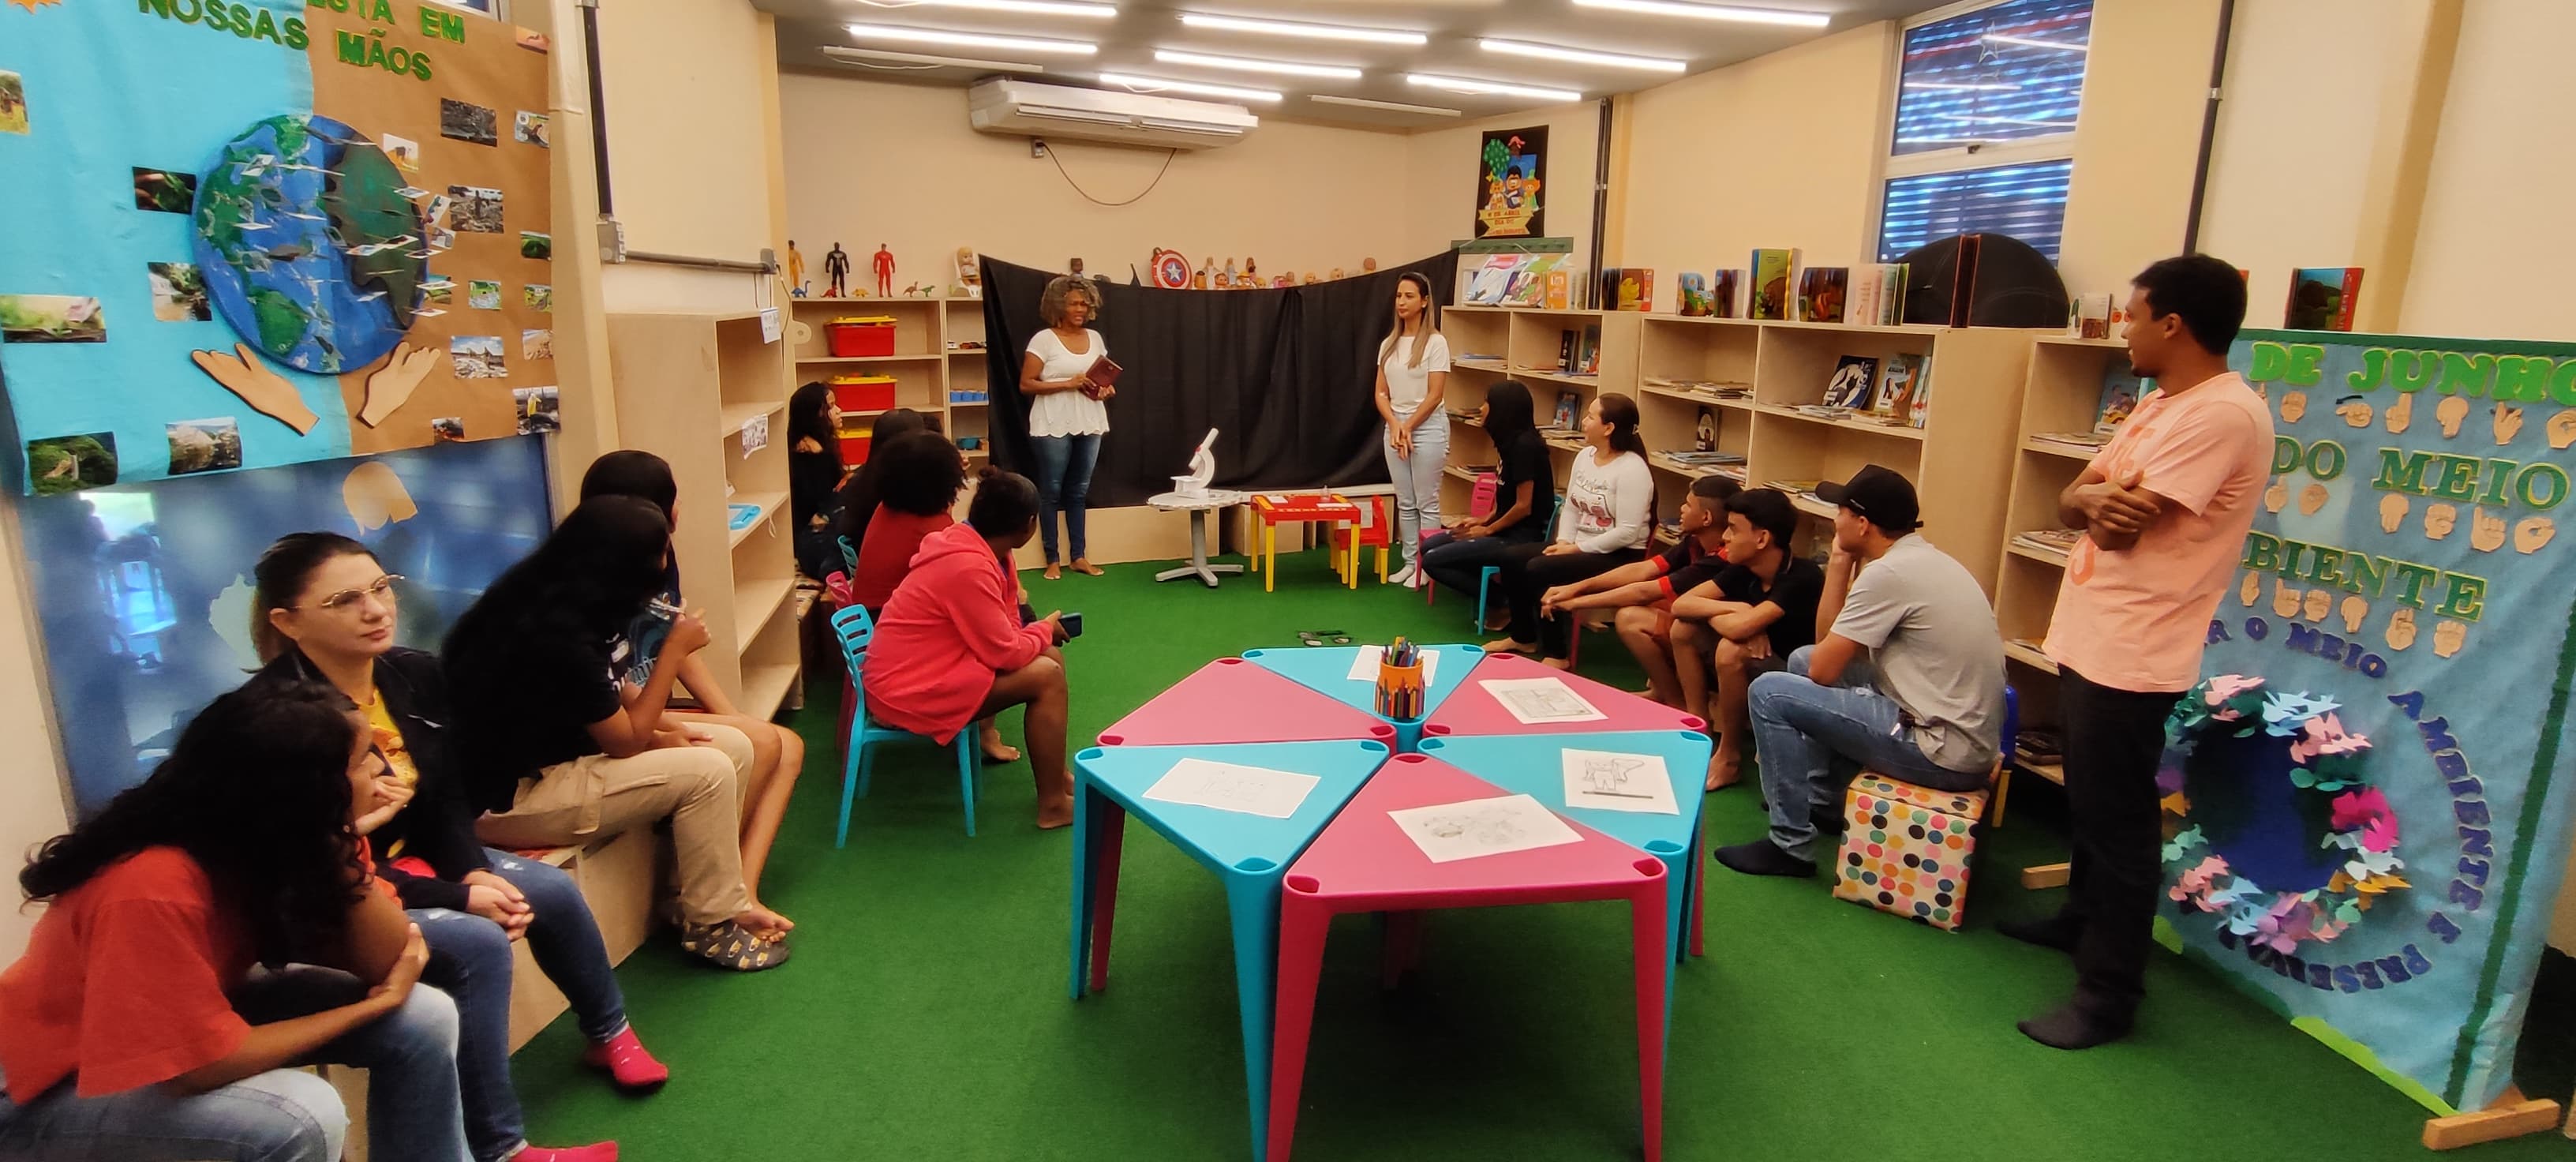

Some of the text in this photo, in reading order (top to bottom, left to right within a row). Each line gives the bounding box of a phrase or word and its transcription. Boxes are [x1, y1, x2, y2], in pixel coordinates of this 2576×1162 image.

[335, 28, 432, 81] MÃOS
[419, 6, 466, 44] EM
[2248, 341, 2576, 406] DE JUNHO
[2273, 434, 2570, 511] DO MEIO
[2242, 530, 2488, 620] BIENTE
[2245, 616, 2268, 640] O
[2285, 622, 2387, 678] MEIO
[2387, 691, 2494, 911] AMBIENTE
